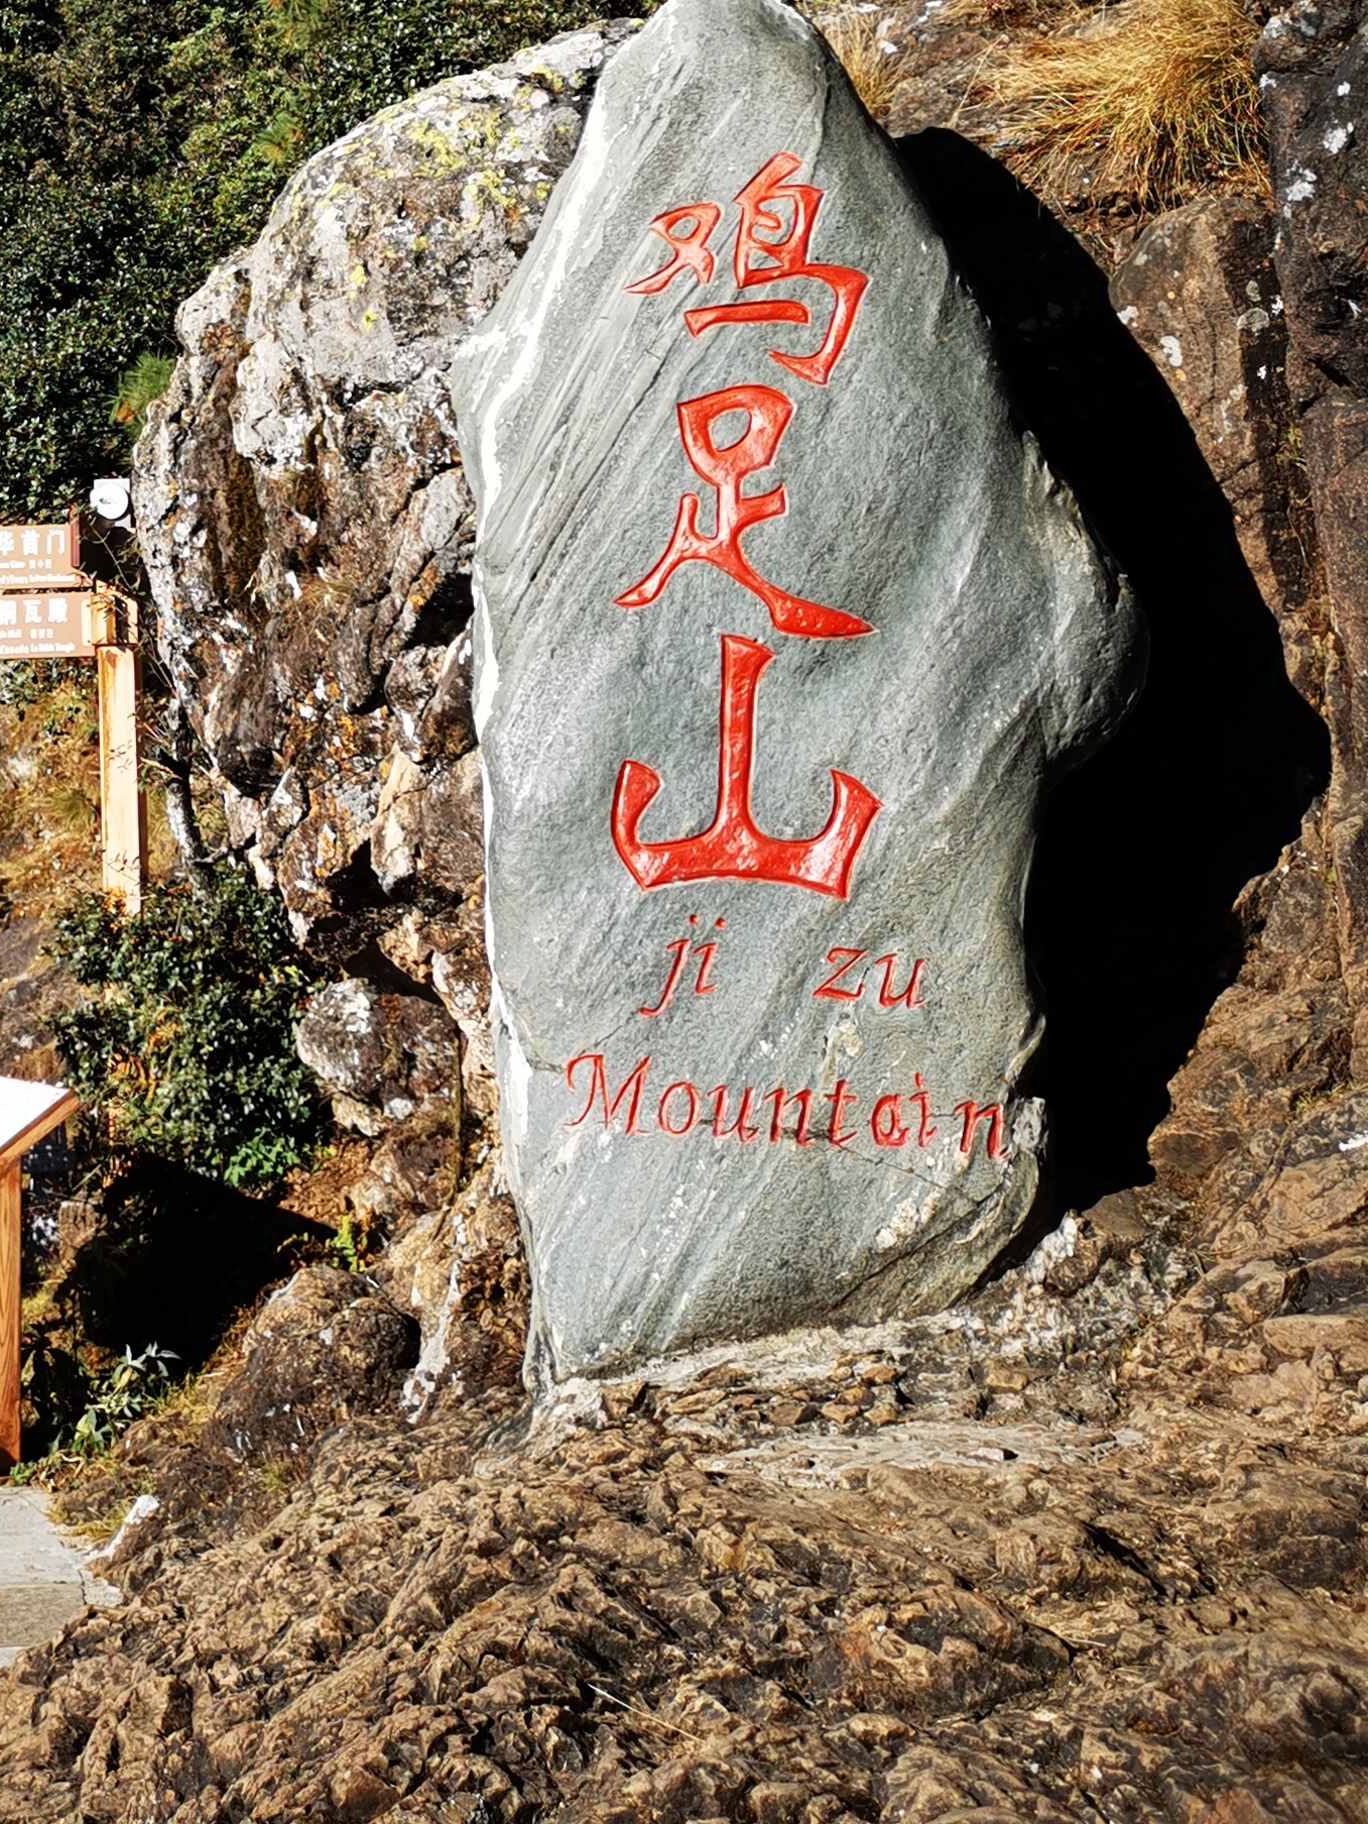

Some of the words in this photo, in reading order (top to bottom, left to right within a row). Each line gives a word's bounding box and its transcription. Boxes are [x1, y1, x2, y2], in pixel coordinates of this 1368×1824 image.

[610, 150, 883, 901] 鸡足山
[638, 913, 727, 1019] ji
[812, 946, 927, 1009] zu
[563, 1053, 1013, 1163] Mountain
